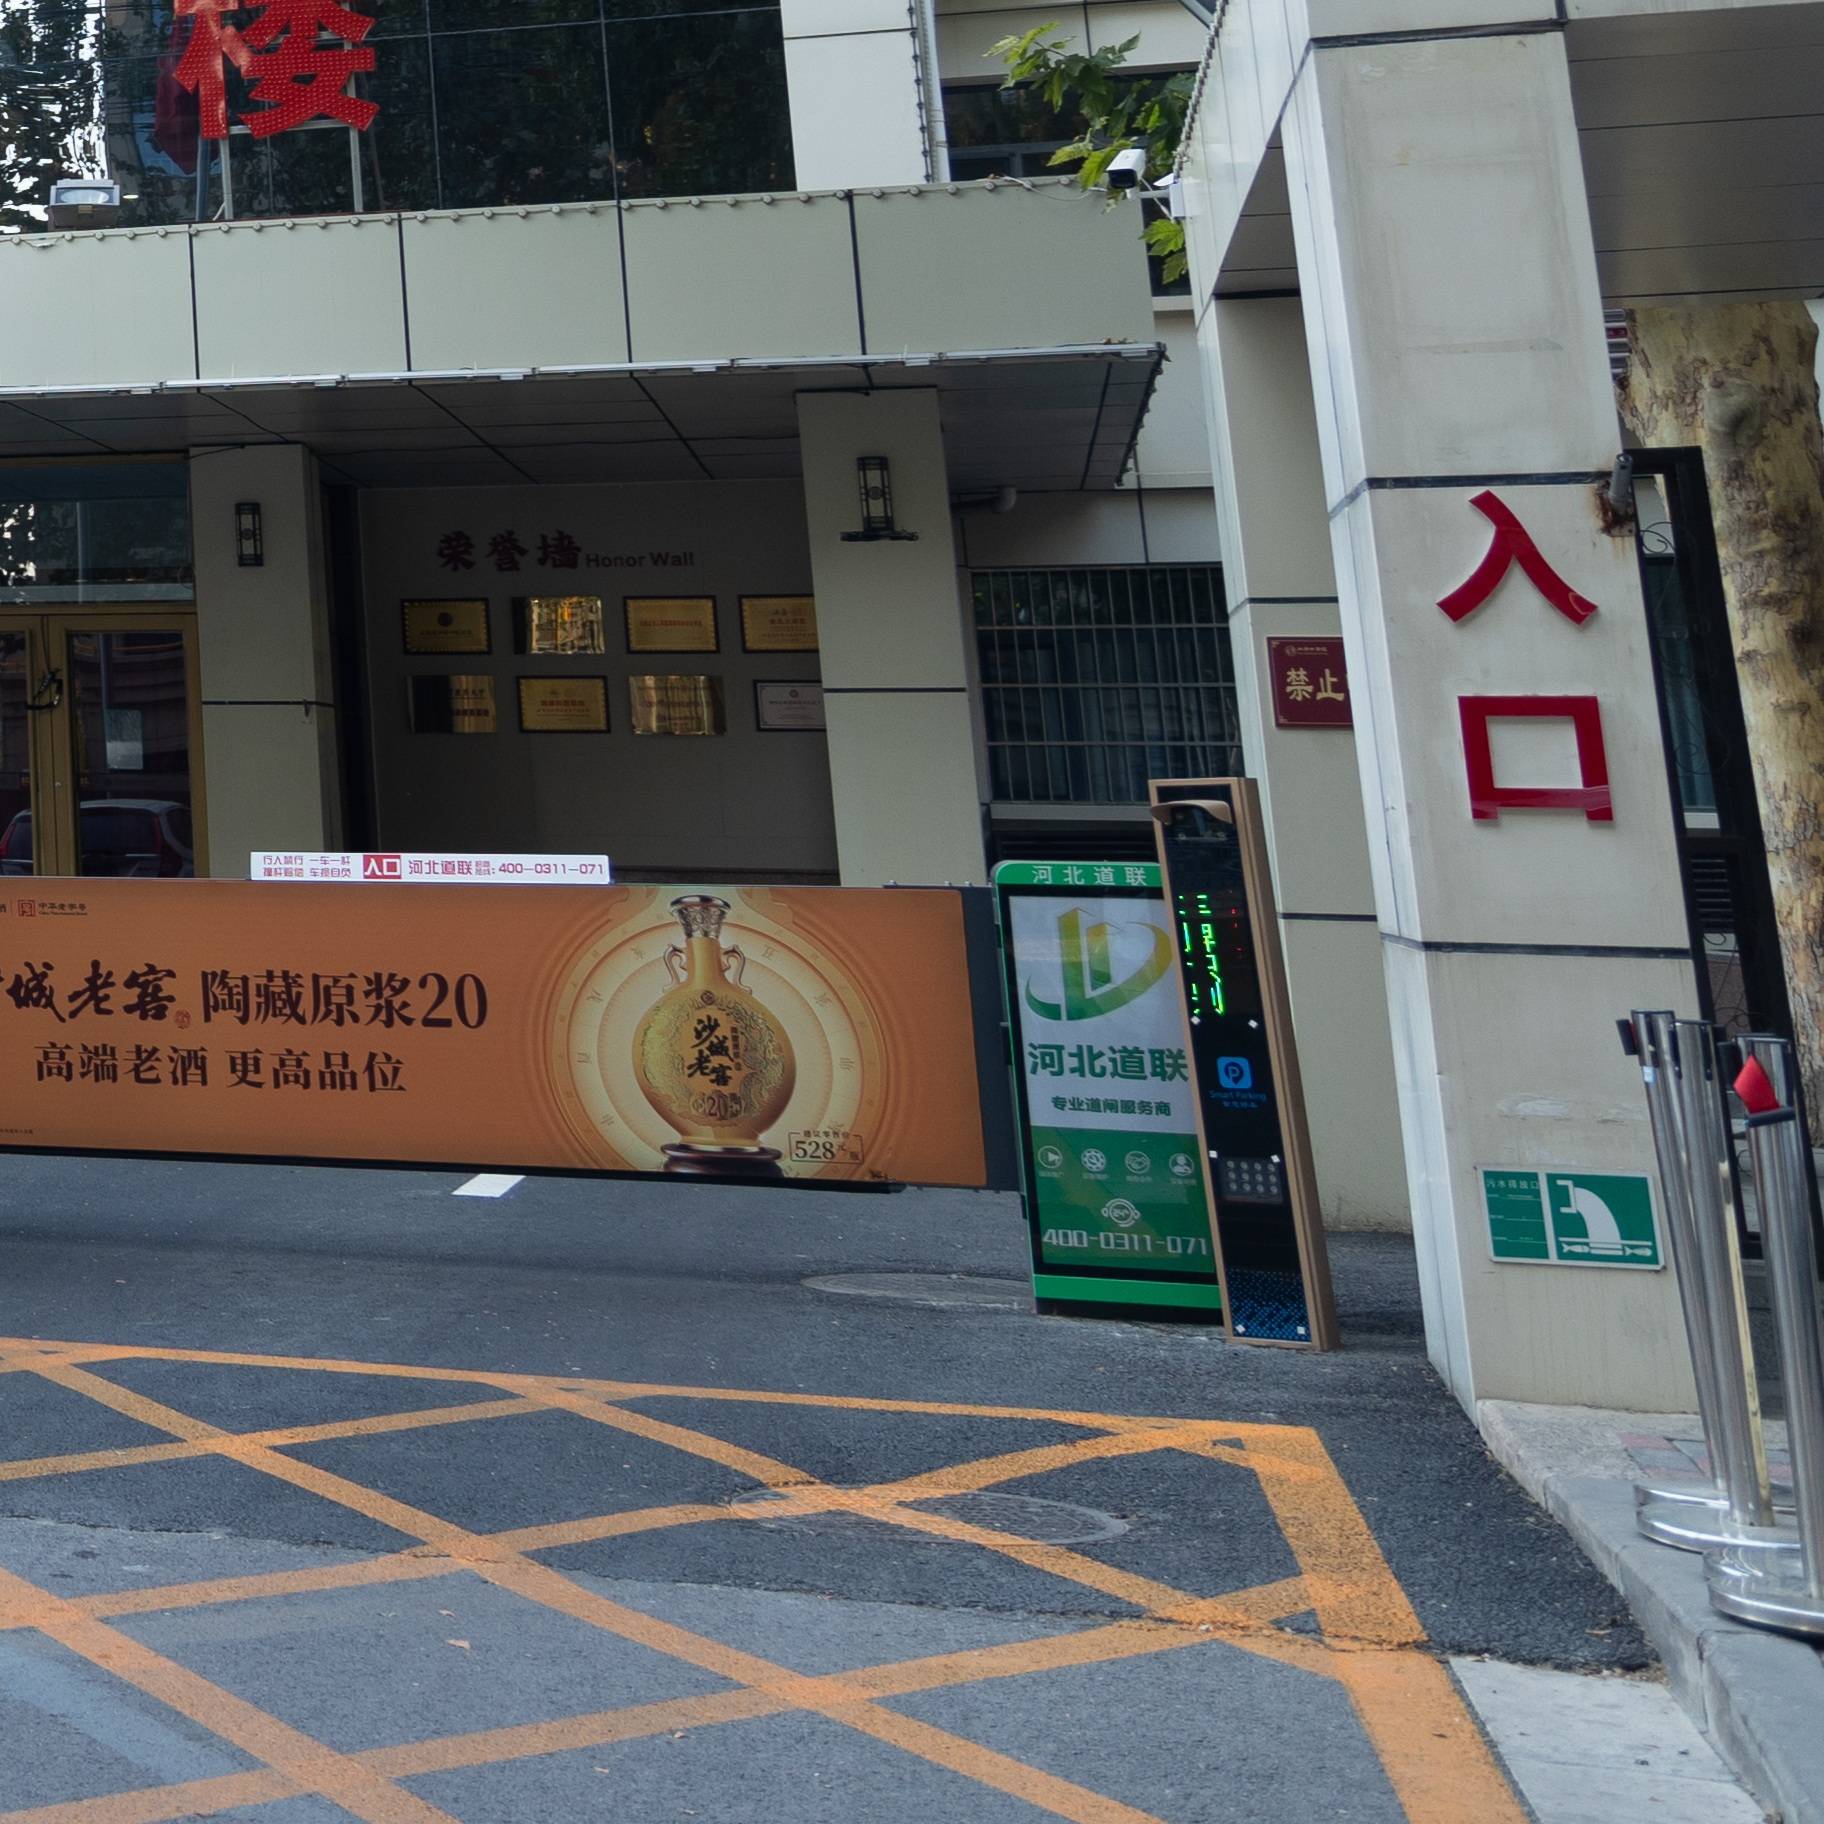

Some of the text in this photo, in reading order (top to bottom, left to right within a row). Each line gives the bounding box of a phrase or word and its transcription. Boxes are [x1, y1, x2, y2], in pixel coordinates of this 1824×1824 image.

[436, 529, 583, 573] 荣誉墙
[585, 551, 695, 568] Honor Wall
[1436, 489, 1615, 823] 入口
[1285, 667, 1345, 702] 禁止
[364, 856, 401, 878] 入口
[408, 859, 473, 875] 河北道联
[1032, 865, 1148, 887] 河北道联
[201, 969, 489, 1030] 陶藏原浆20
[33, 1041, 407, 1093] 高端老酒 更高品位
[1027, 1042, 1190, 1082] 河北道联
[1051, 1095, 1173, 1118] 专业道闸服务商
[1042, 1228, 1209, 1256] 400-0311-071
